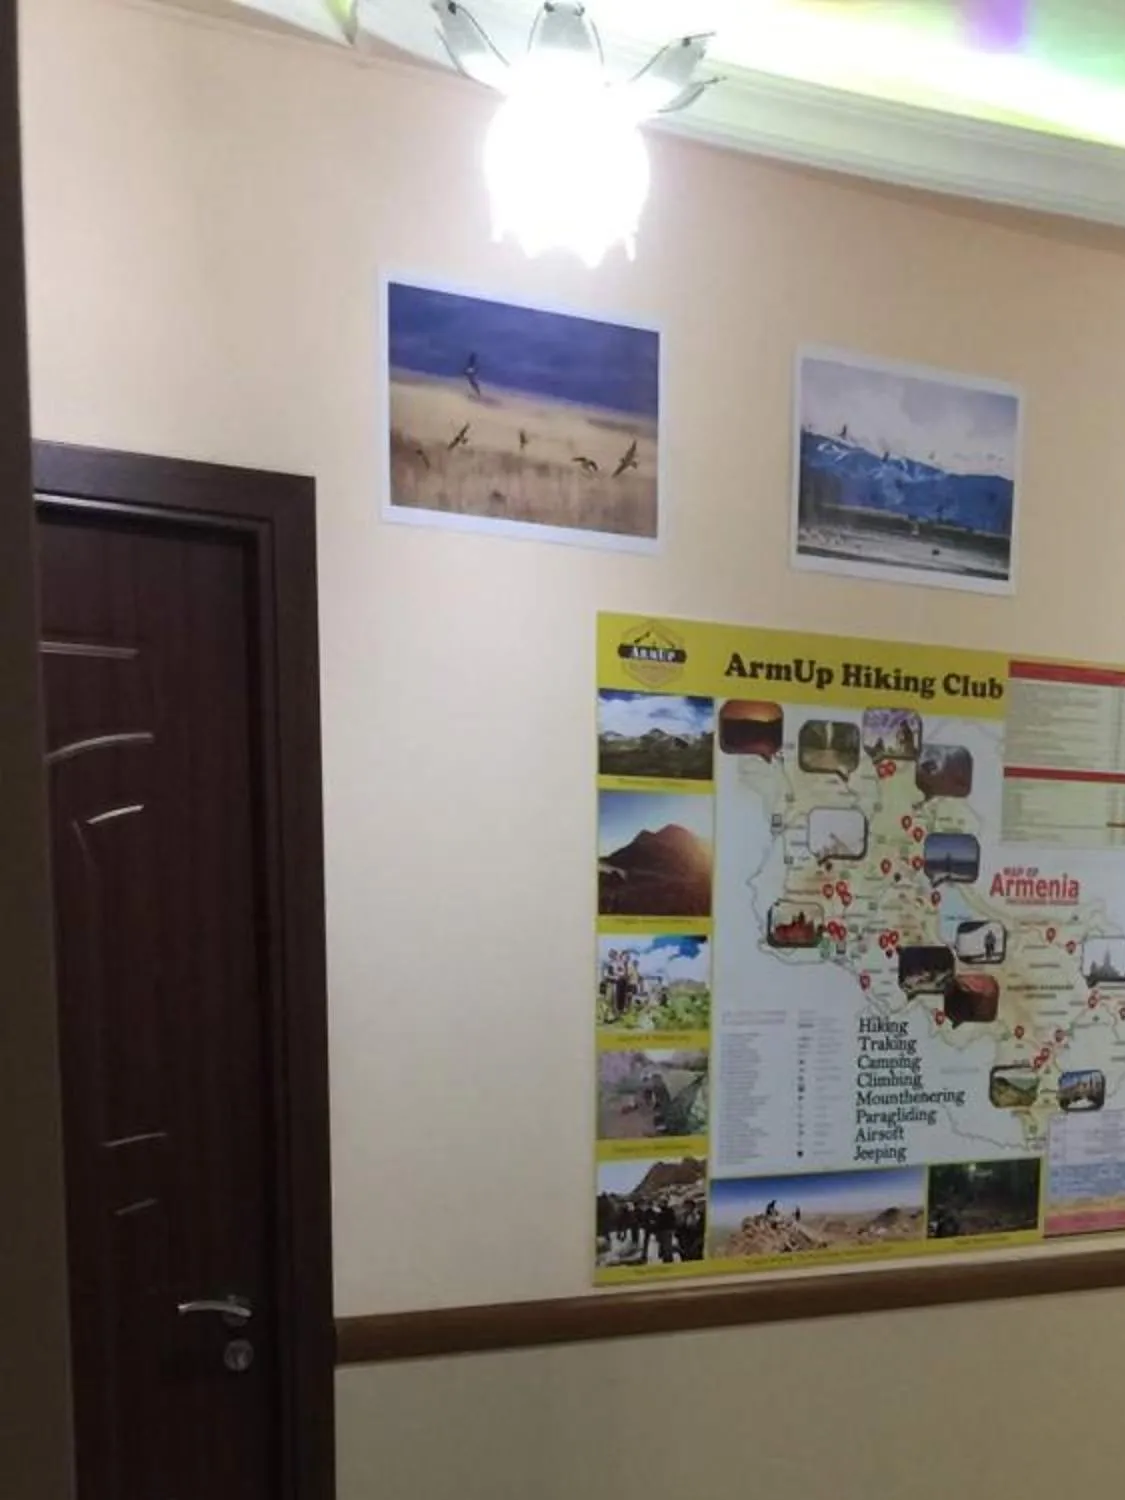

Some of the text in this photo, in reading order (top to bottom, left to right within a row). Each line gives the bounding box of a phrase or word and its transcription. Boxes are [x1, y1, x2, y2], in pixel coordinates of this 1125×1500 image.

[724, 652, 834, 690] ArmUp
[842, 663, 937, 699] Hiking
[943, 672, 1004, 699] Club
[989, 872, 1080, 898] Armenia
[859, 1017, 909, 1038] Hiking
[857, 1036, 918, 1055] Traking
[857, 1054, 922, 1074] Camping
[857, 1071, 924, 1090] Climbing
[856, 1107, 937, 1128] Paragliding
[855, 1125, 905, 1142] Airsoft
[853, 1145, 908, 1164] Jeeping
